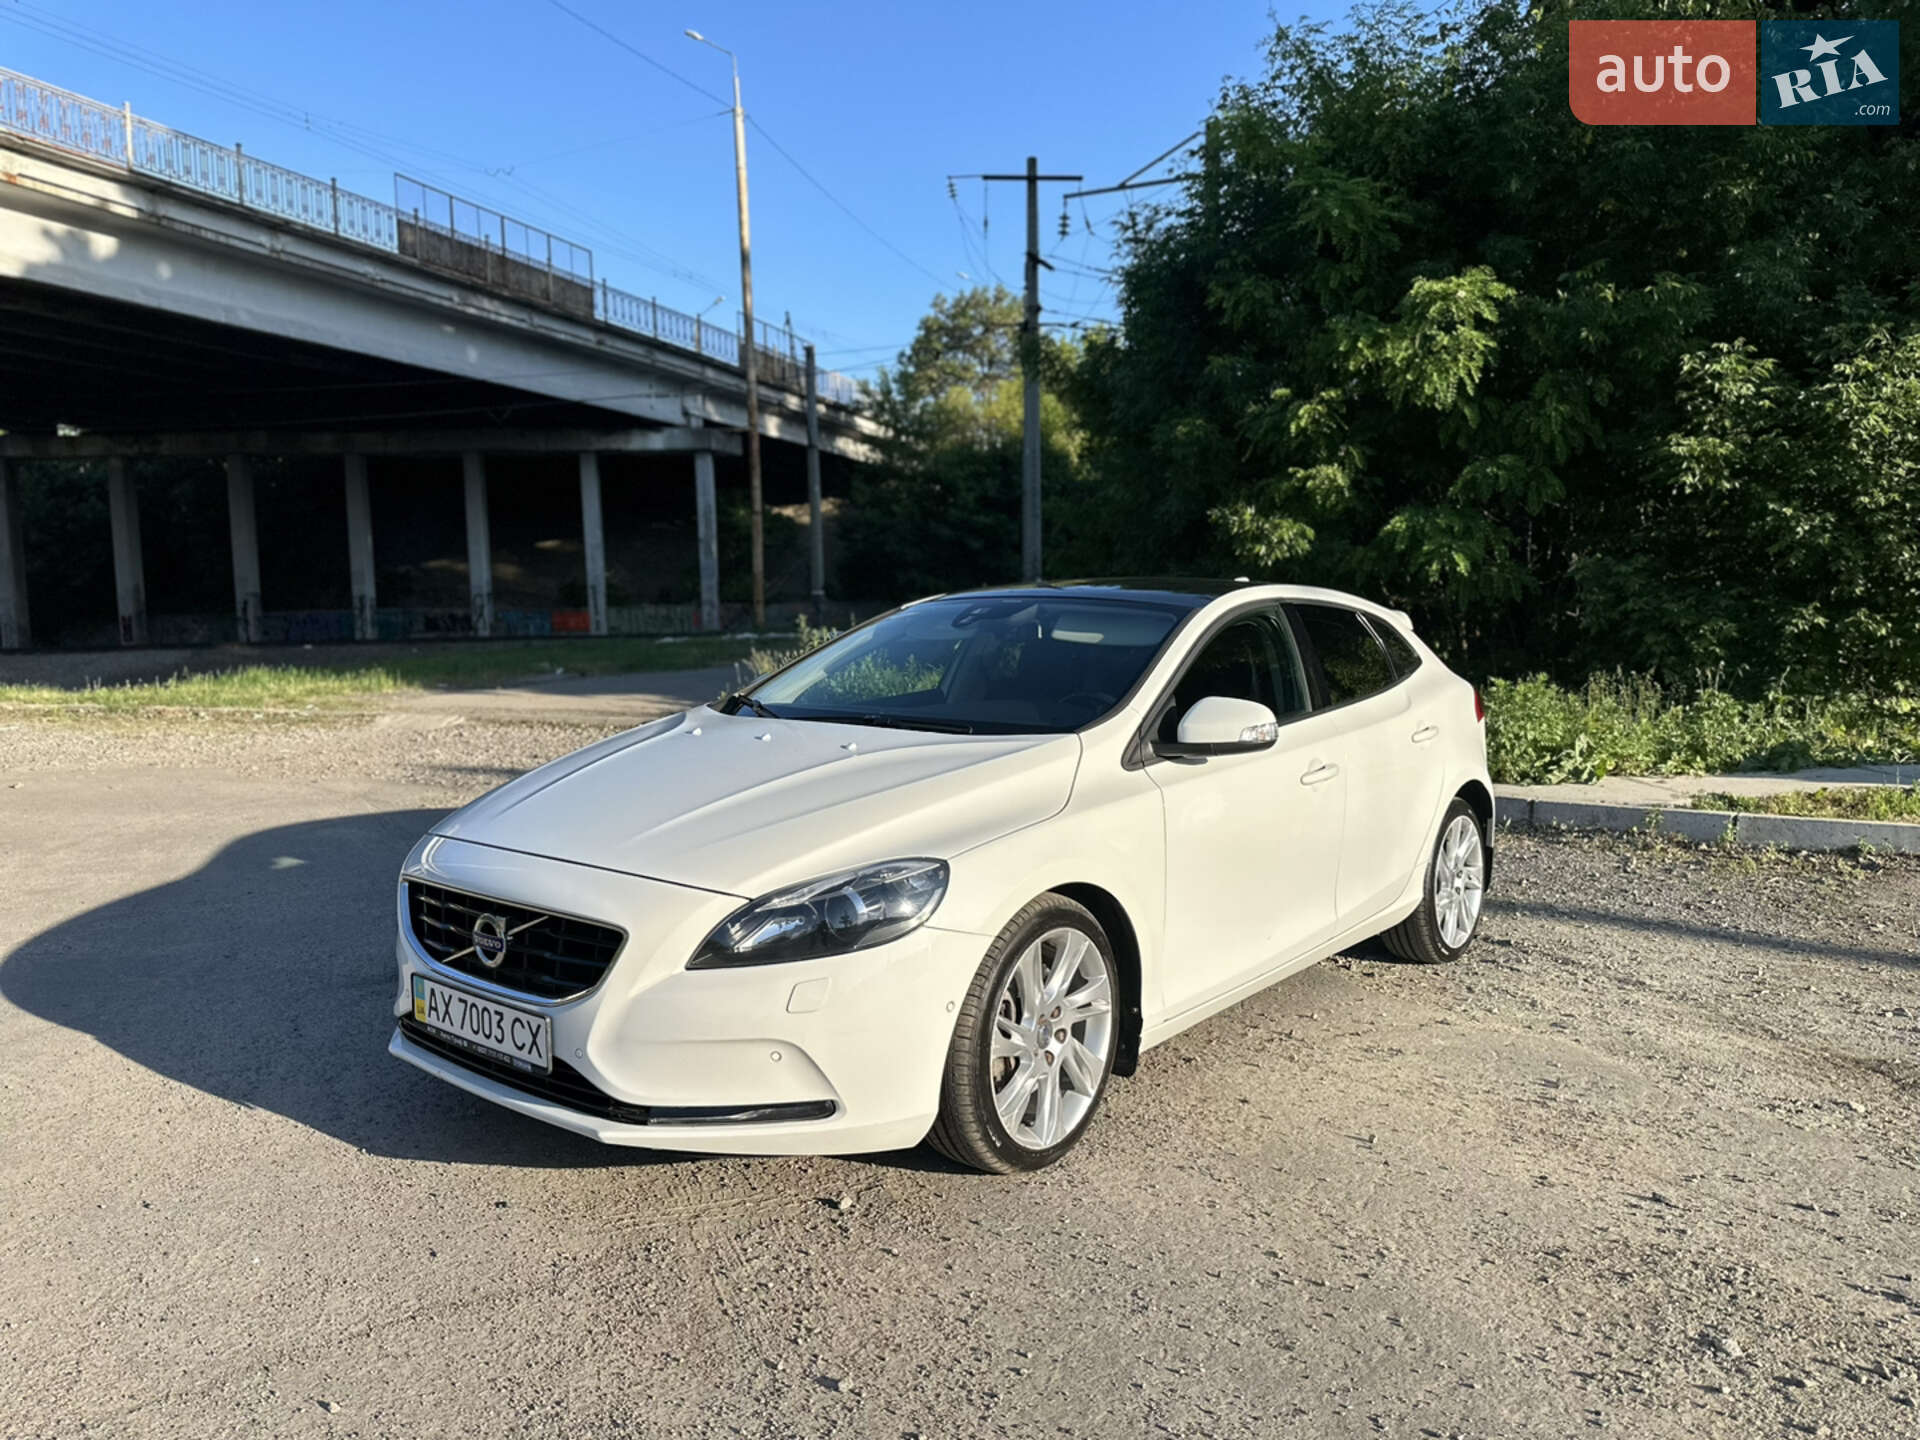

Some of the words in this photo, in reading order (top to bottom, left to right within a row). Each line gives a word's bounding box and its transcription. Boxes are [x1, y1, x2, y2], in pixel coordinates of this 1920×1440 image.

[428, 987, 454, 1027] AX
[458, 997, 505, 1044] 7003
[511, 1017, 543, 1058] CX
